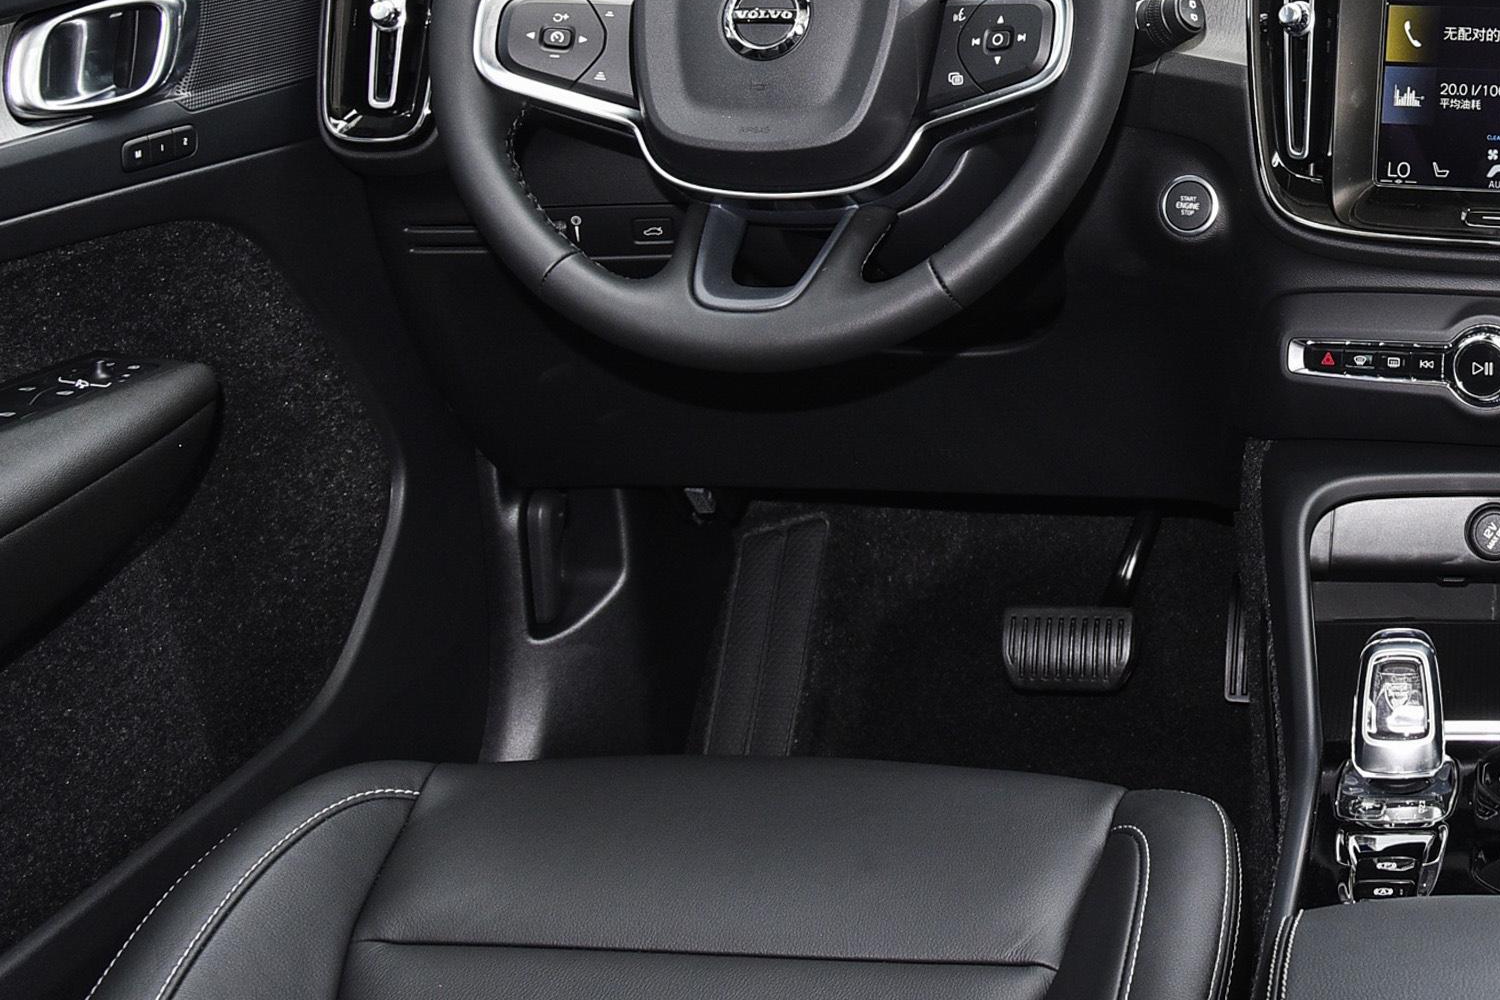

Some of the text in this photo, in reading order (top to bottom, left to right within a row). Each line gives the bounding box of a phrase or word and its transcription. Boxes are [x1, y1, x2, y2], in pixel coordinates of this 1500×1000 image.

[734, 10, 793, 19] VOLVO
[1440, 83, 1468, 96] 20.0
[1439, 98, 1482, 111] 平均油耗
[1387, 161, 1411, 179] LO
[1175, 201, 1200, 210] ENGINE
[1483, 522, 1498, 539] 12V
